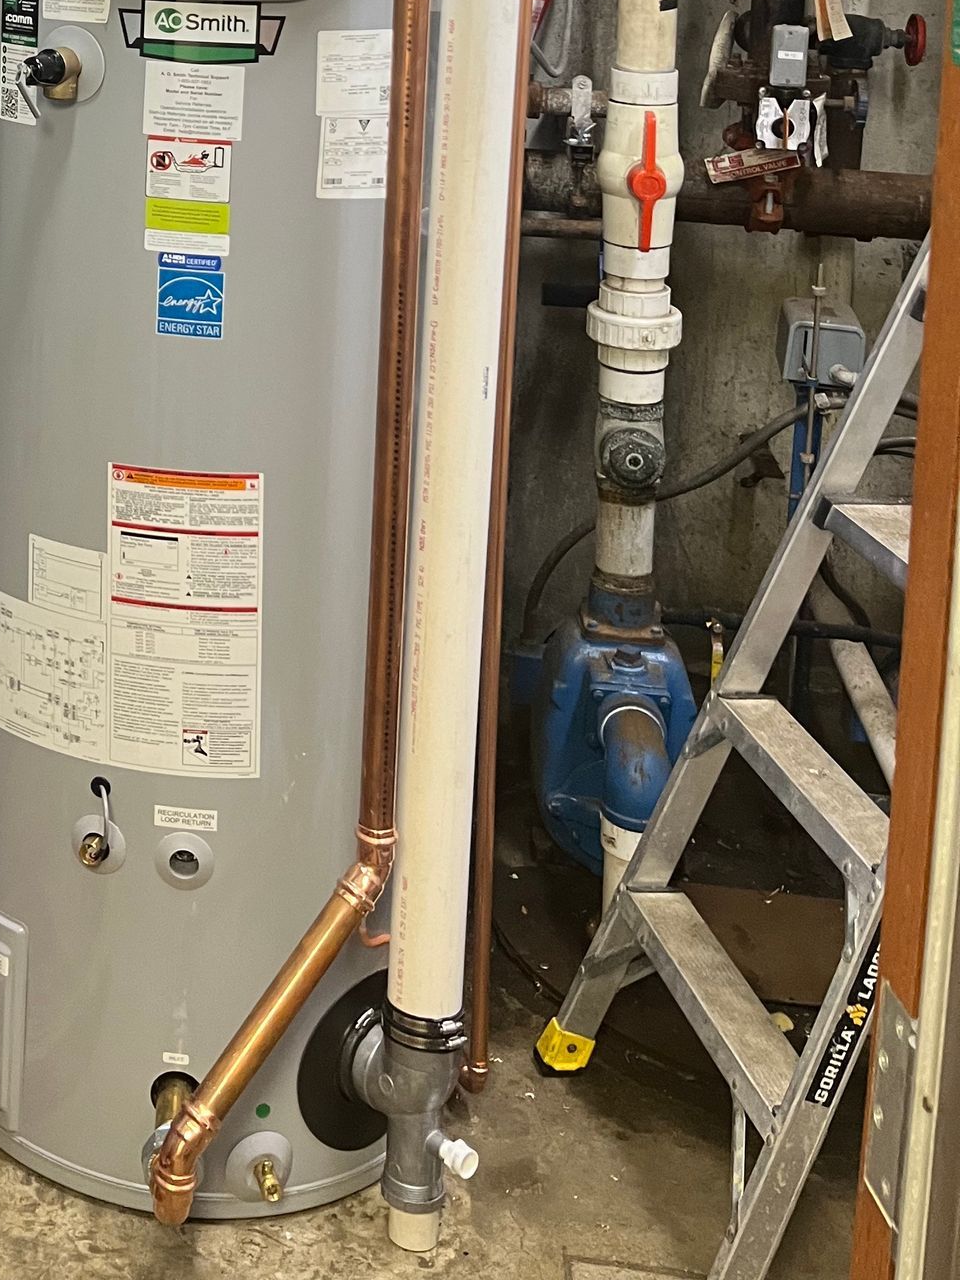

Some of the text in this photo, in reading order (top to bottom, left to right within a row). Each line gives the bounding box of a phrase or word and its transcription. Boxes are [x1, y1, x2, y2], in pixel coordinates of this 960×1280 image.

[186, 13, 246, 33] Smith
[159, 321, 220, 336] ENERGY STAR
[157, 809, 215, 820] RECIRCULATION
[181, 818, 212, 827] RETURN
[814, 1030, 855, 1103] GORILLA
